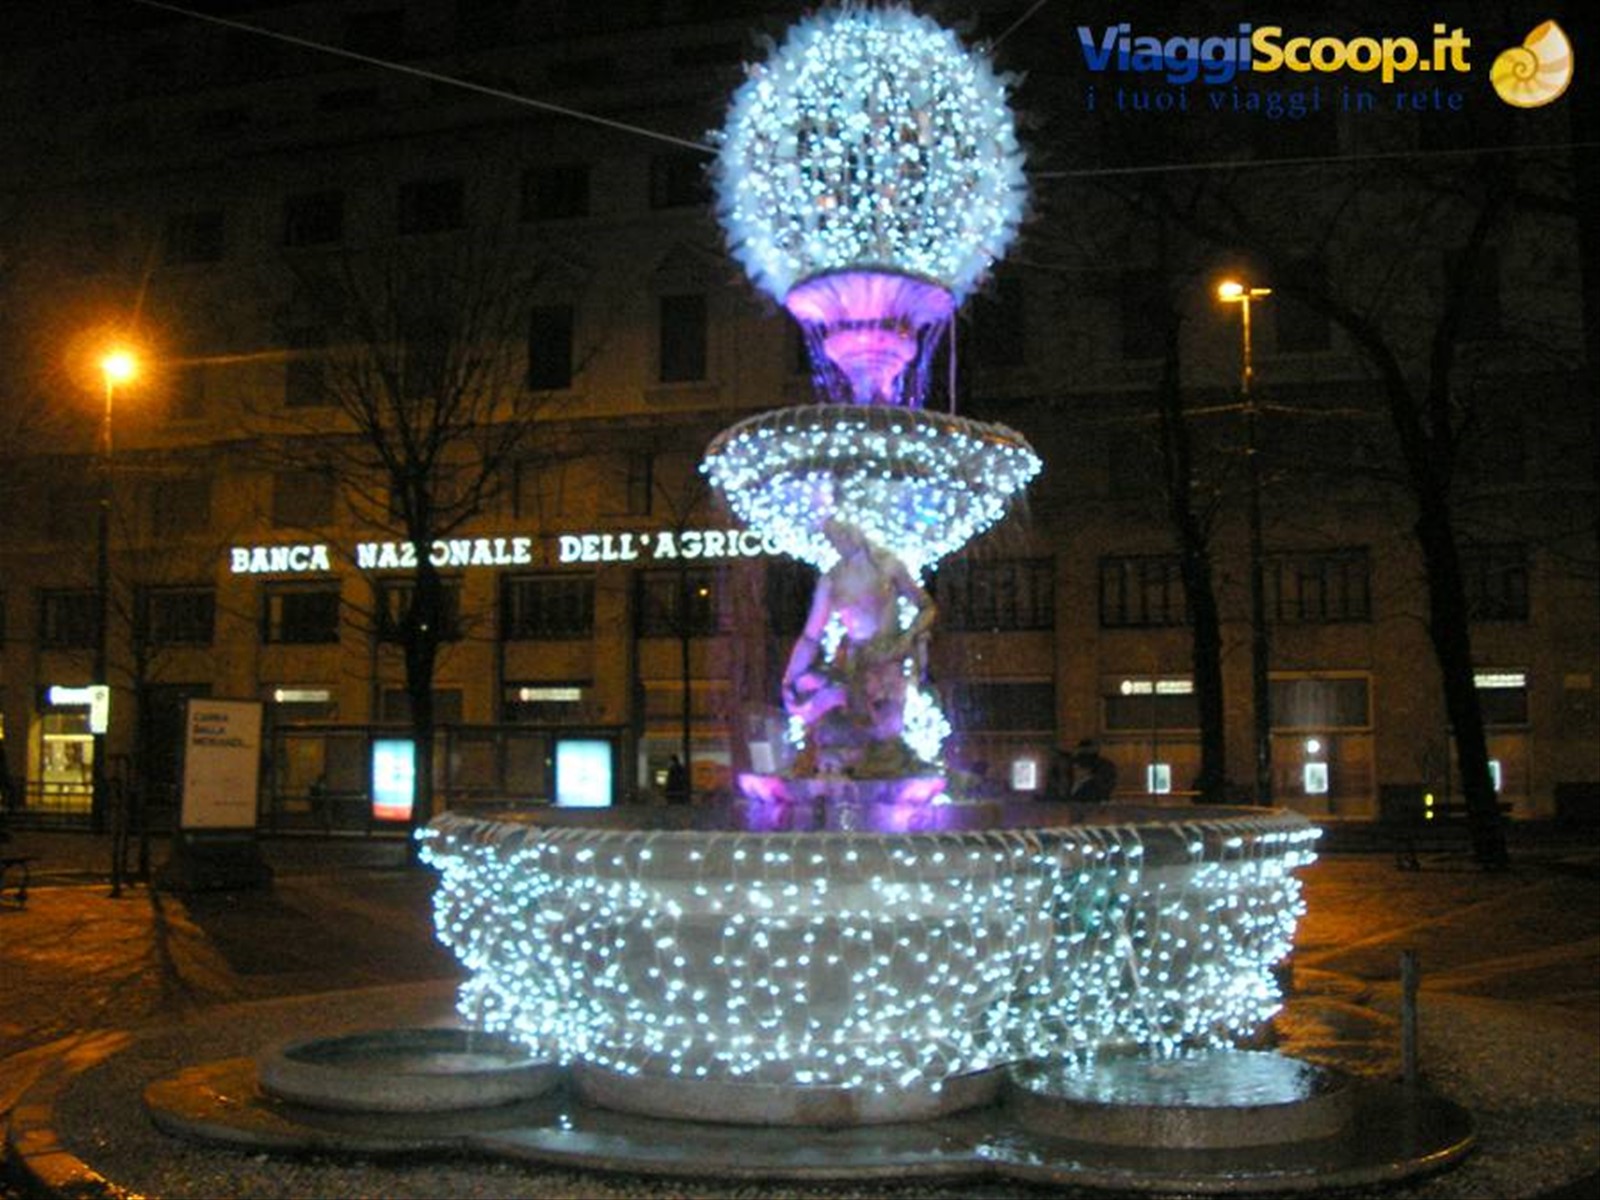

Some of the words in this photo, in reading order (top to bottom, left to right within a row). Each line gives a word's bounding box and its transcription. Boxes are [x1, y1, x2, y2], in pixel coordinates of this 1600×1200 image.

[230, 545, 330, 573] BANCA
[356, 537, 532, 568] NAZONALE
[559, 529, 787, 563] DELL'AGRICO
